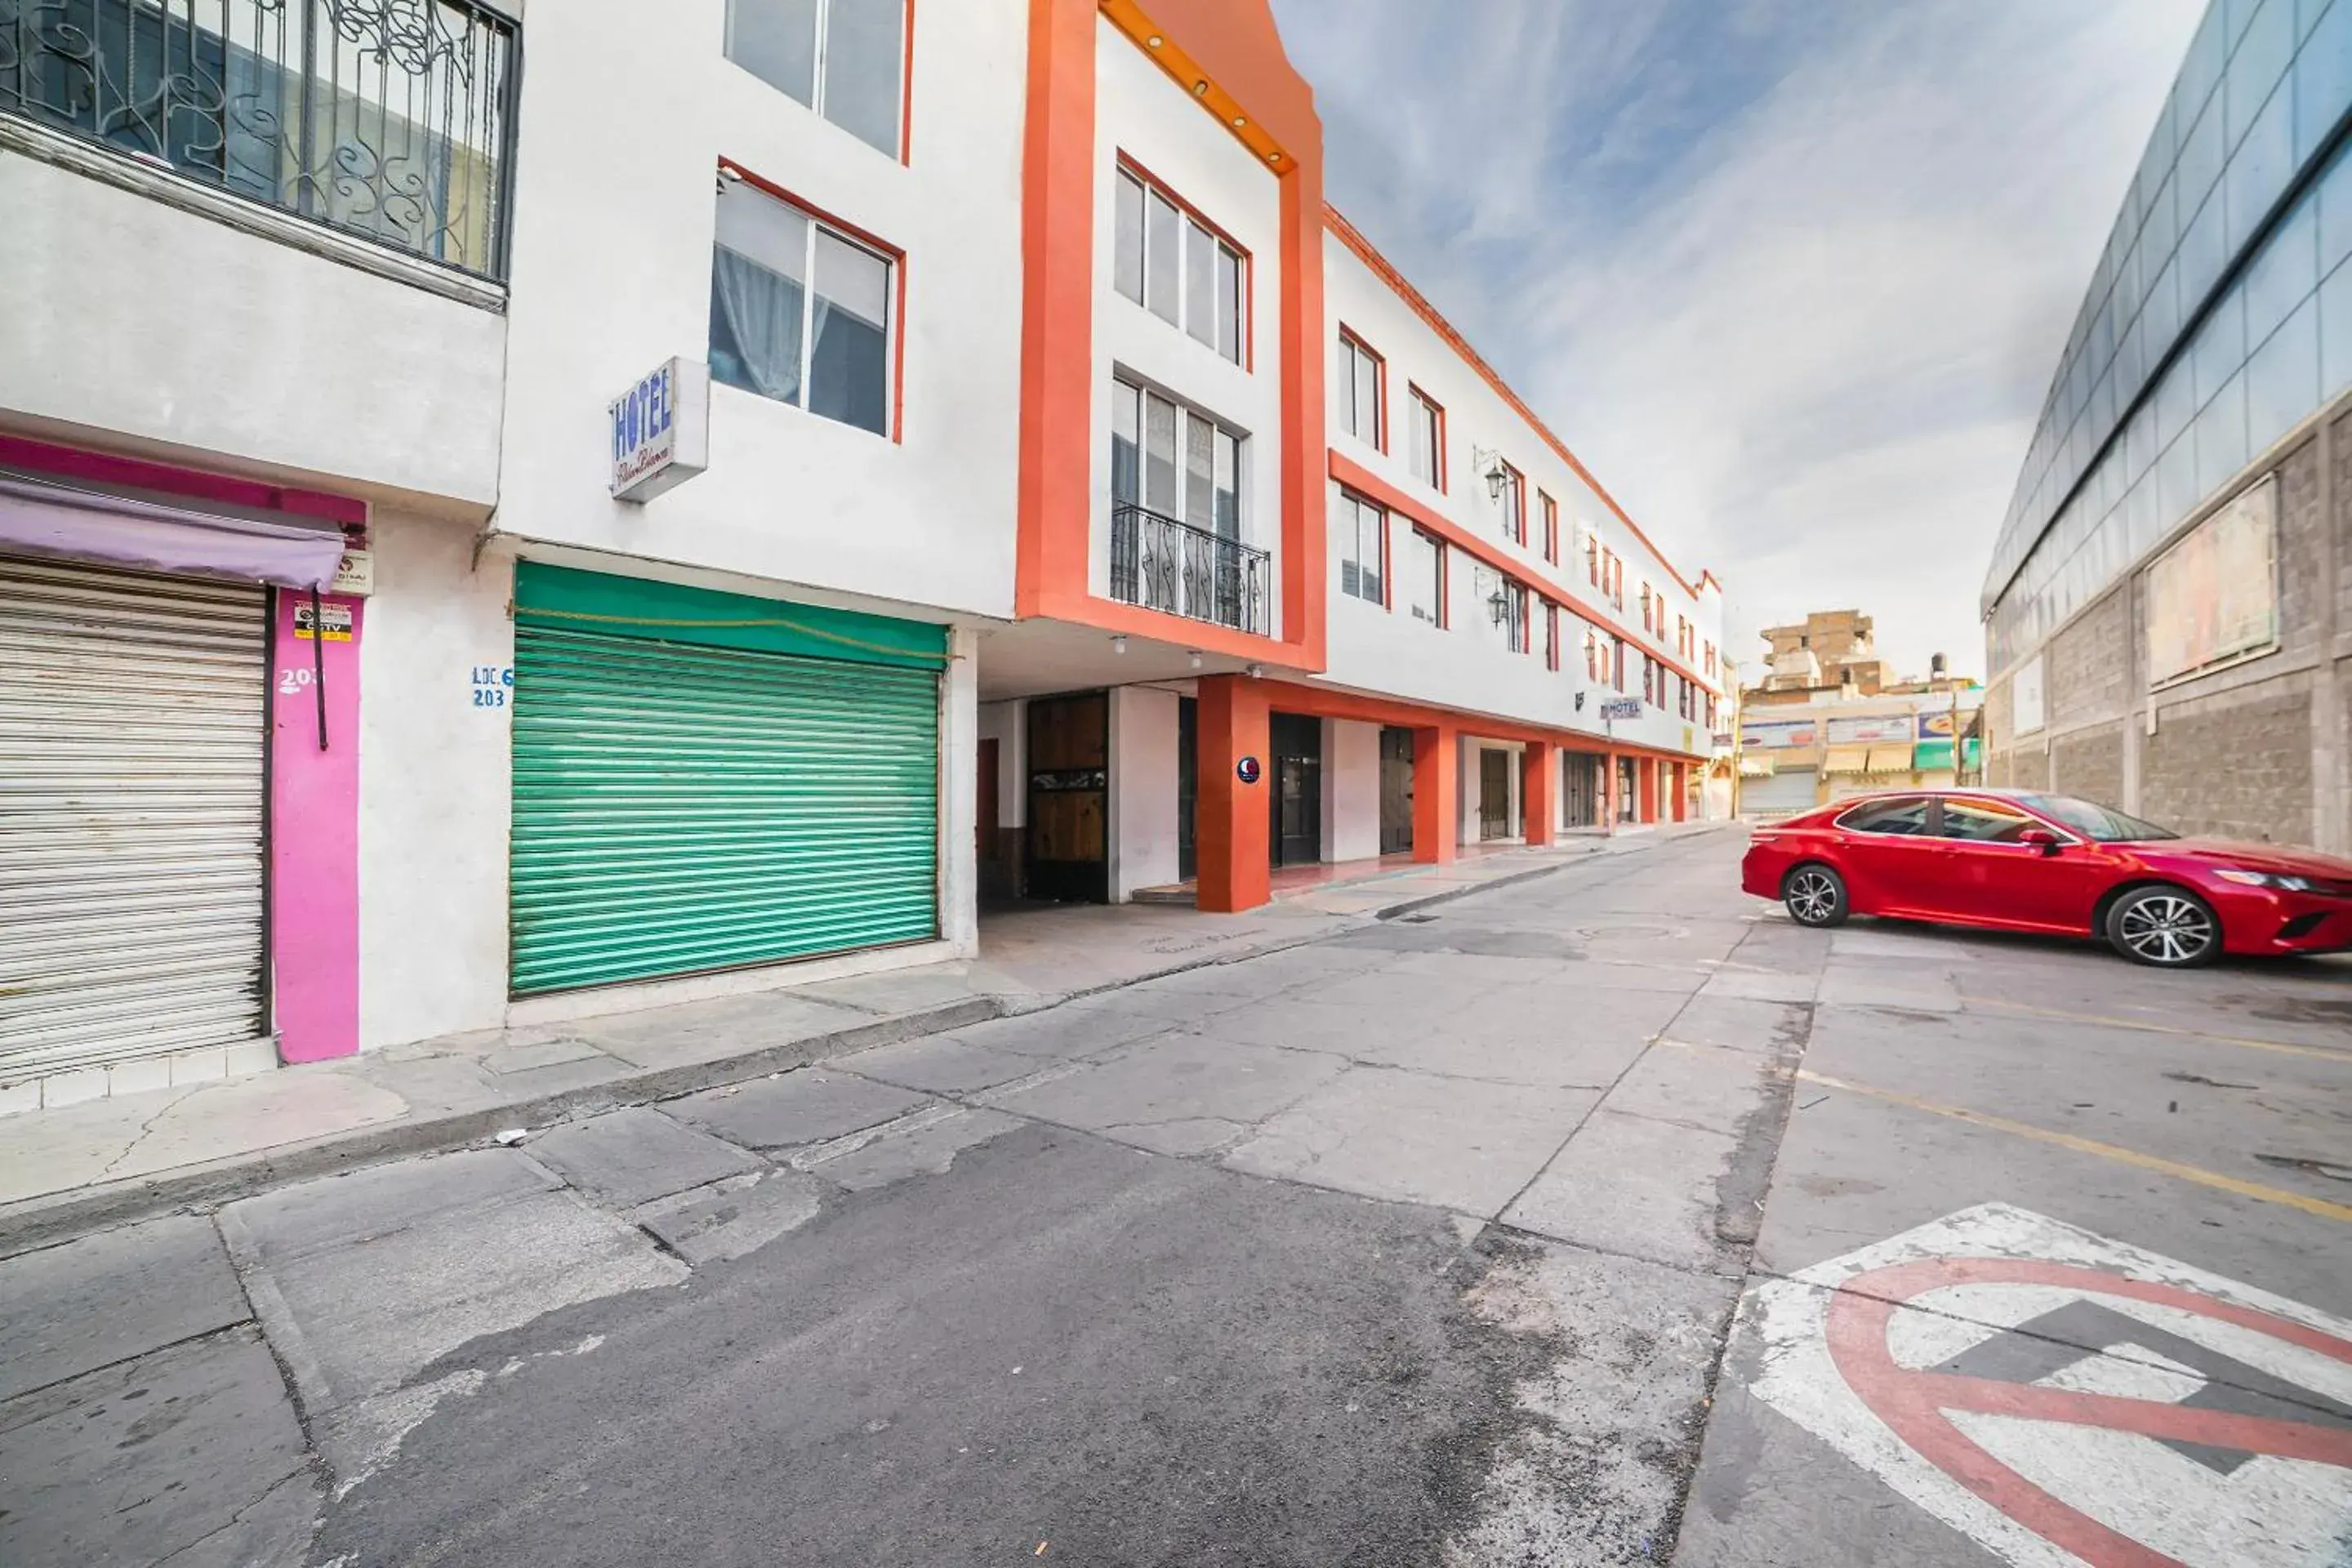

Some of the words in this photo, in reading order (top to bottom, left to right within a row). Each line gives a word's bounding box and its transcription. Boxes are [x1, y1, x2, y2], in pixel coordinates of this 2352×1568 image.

[616, 368, 670, 461] HOTEL
[306, 622, 341, 632] CTV
[502, 669, 515, 686] 6
[474, 689, 504, 706] 203
[1610, 702, 1640, 713] HOTEL
